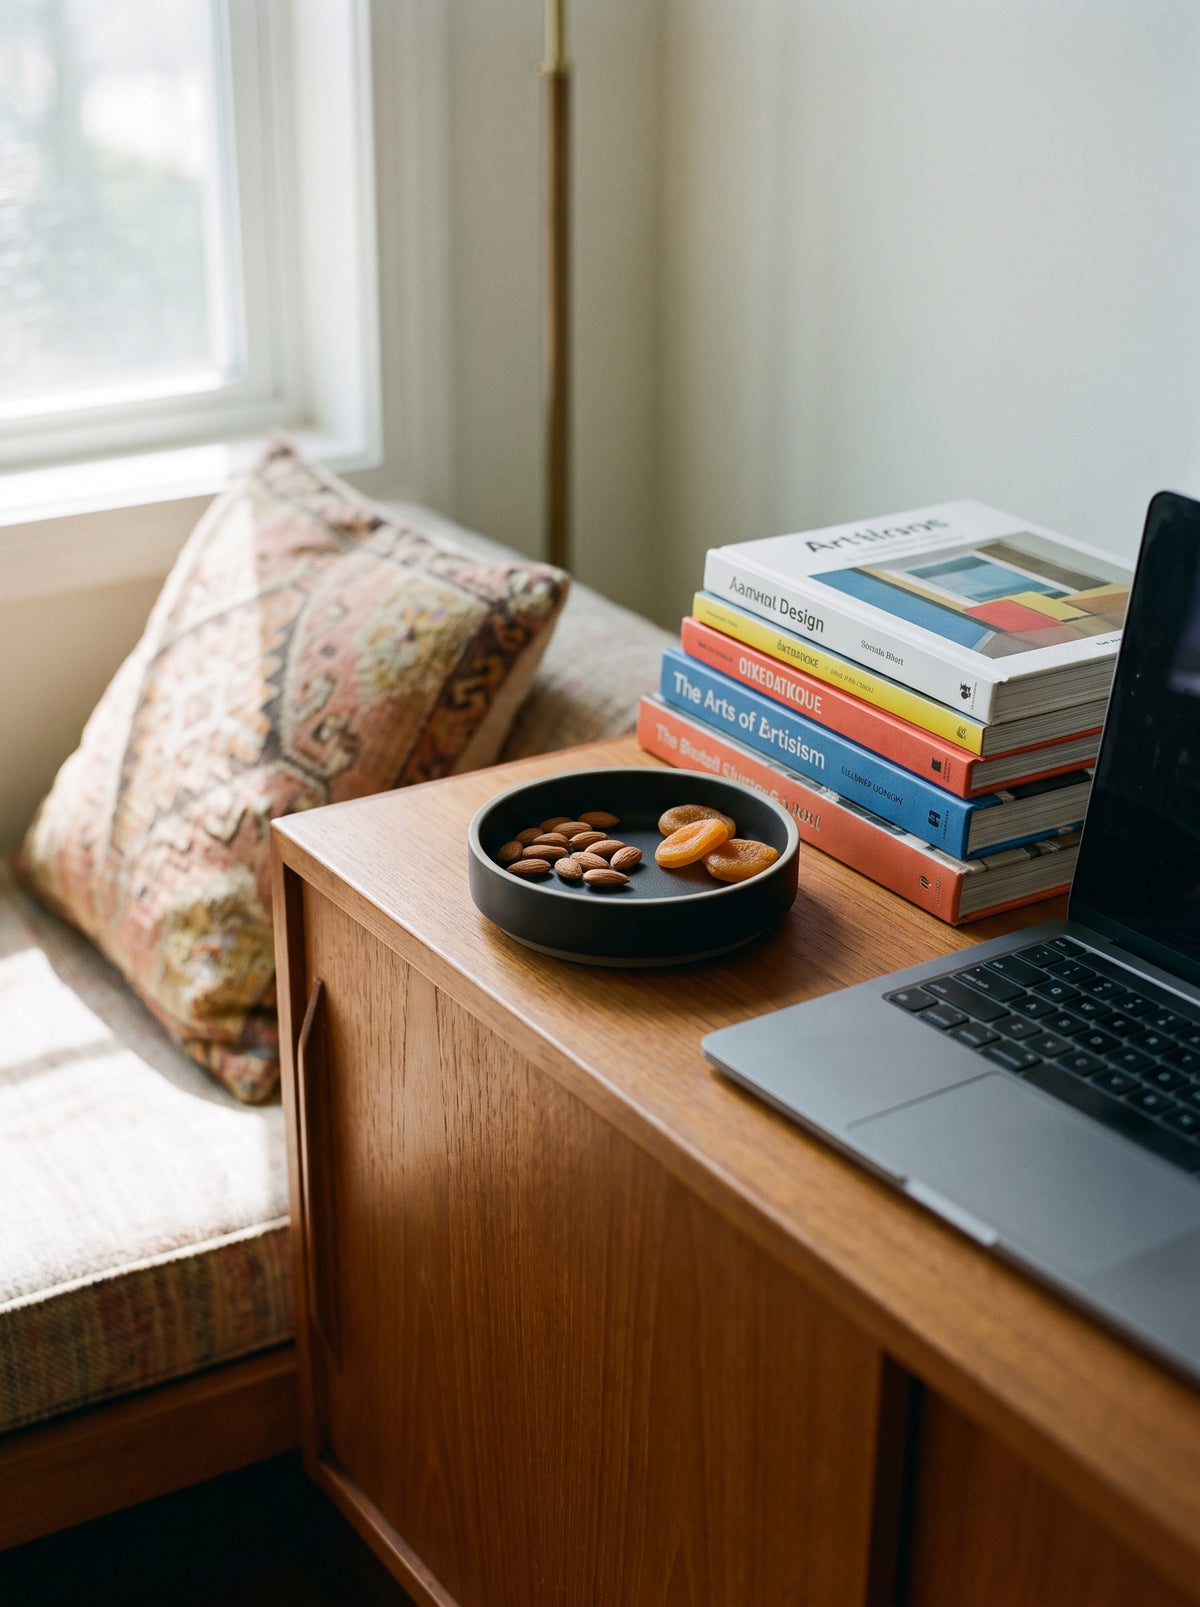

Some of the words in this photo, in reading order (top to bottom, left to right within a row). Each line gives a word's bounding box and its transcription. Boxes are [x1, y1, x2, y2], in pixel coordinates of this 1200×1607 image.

[779, 598, 825, 633] Design
[673, 671, 701, 704] The
[703, 689, 736, 723] Arts
[738, 711, 757, 733] of
